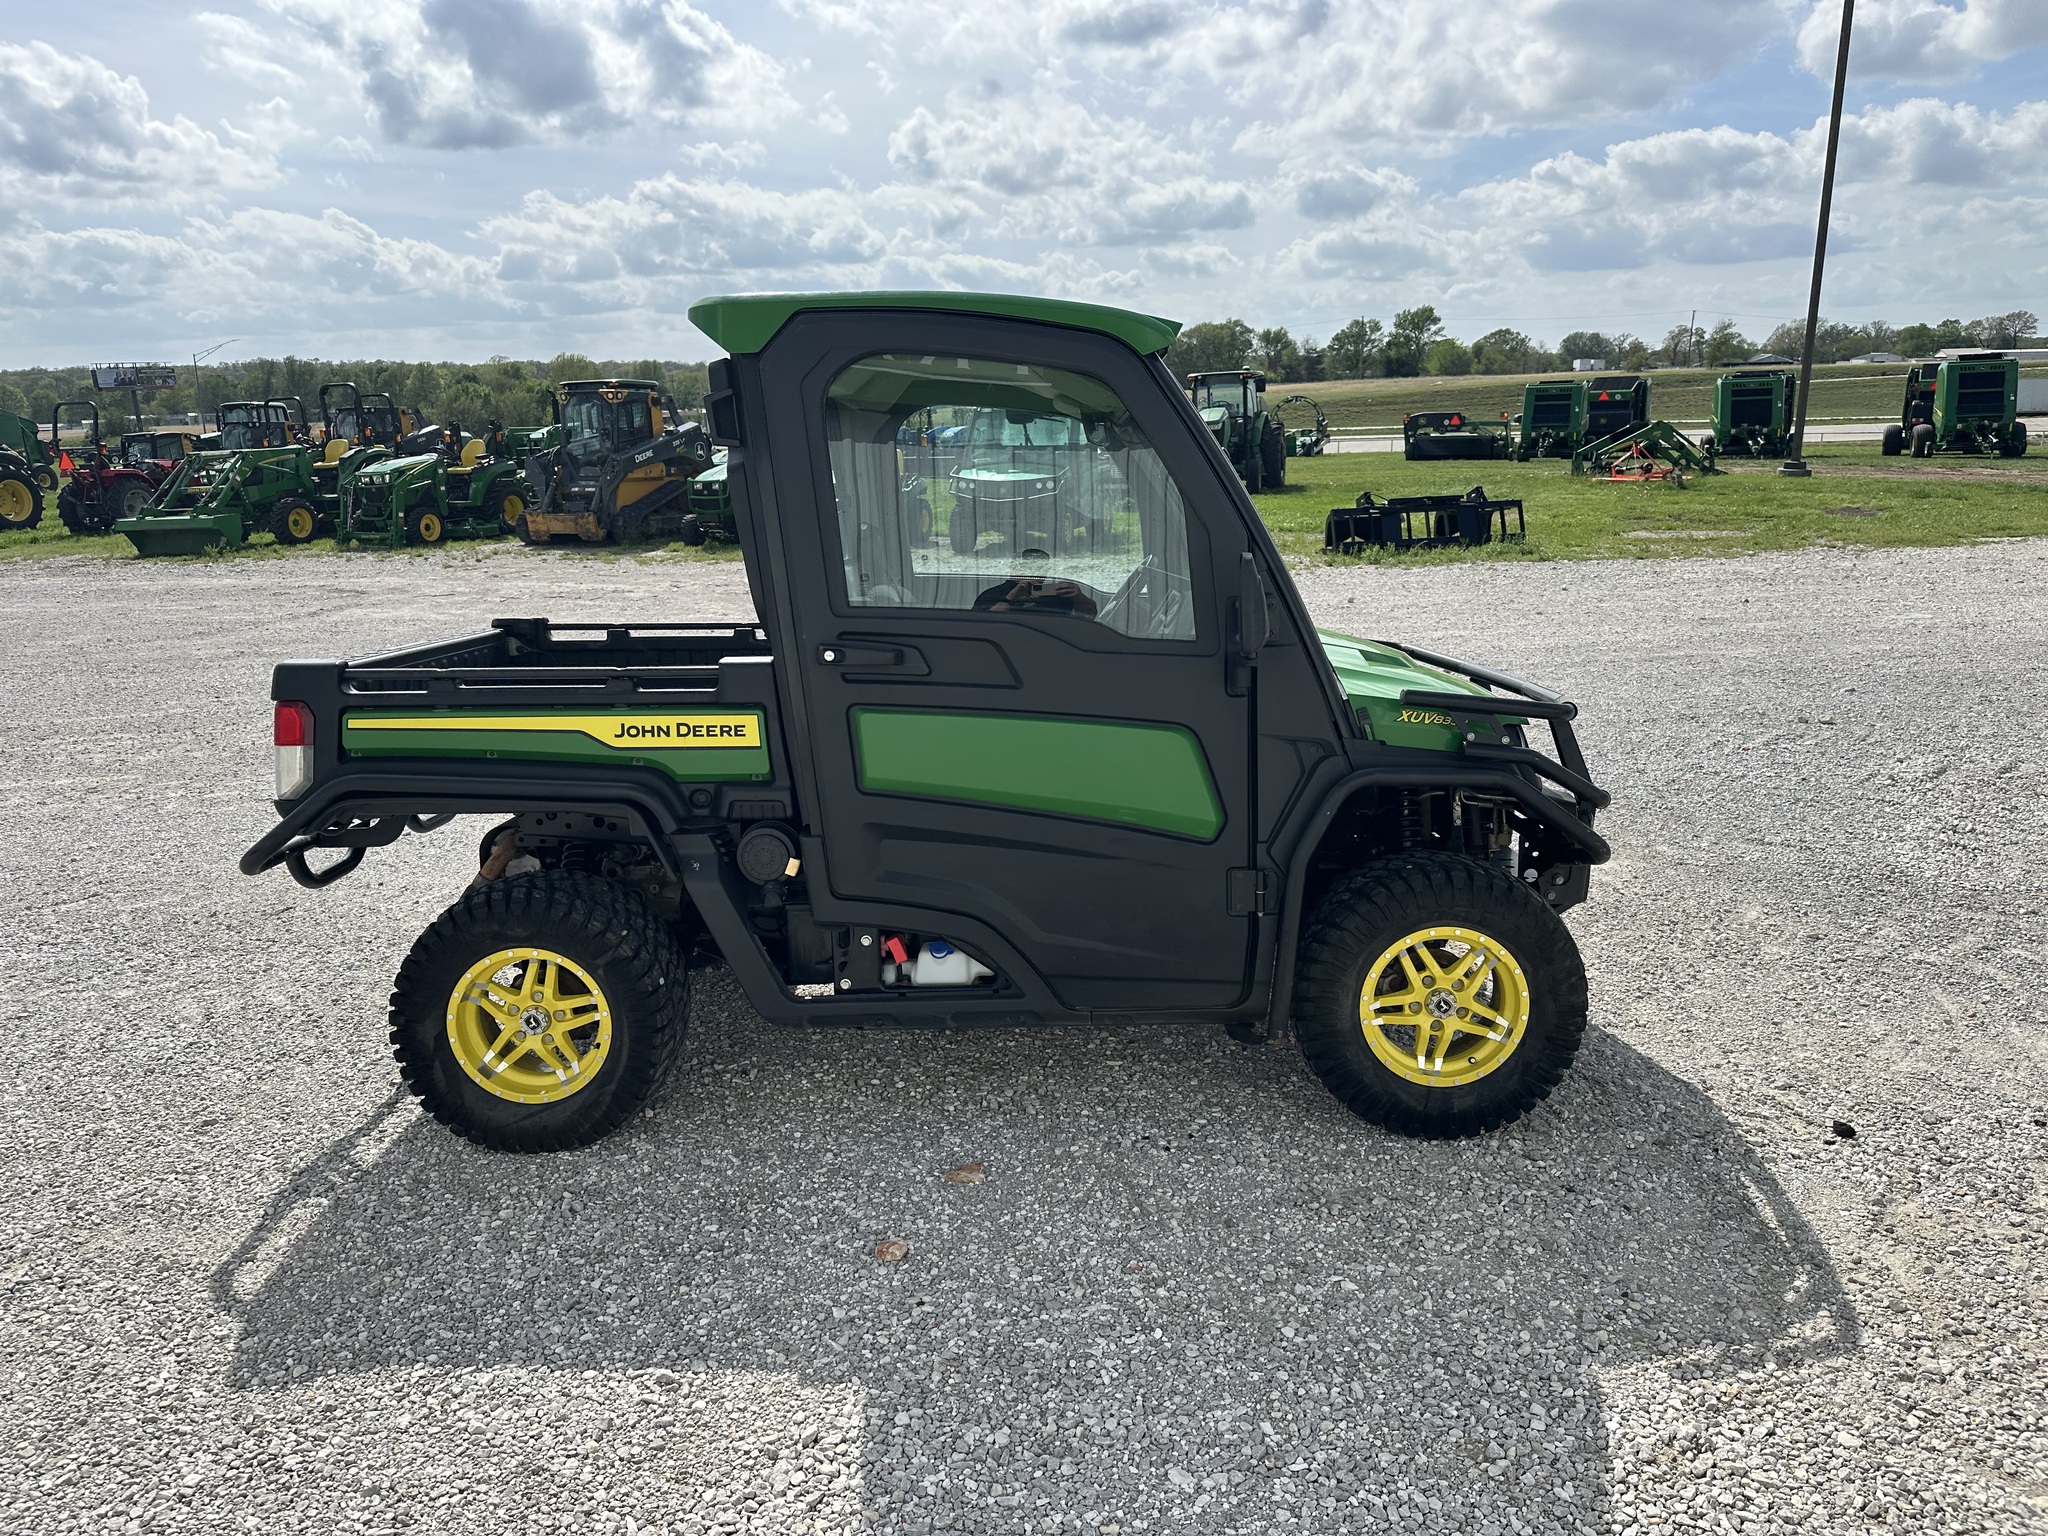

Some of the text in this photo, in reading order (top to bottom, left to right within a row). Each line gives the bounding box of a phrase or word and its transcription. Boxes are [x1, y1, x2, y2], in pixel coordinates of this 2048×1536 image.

[634, 449, 654, 463] DEERE
[614, 723, 746, 738] JOHN DEERE
